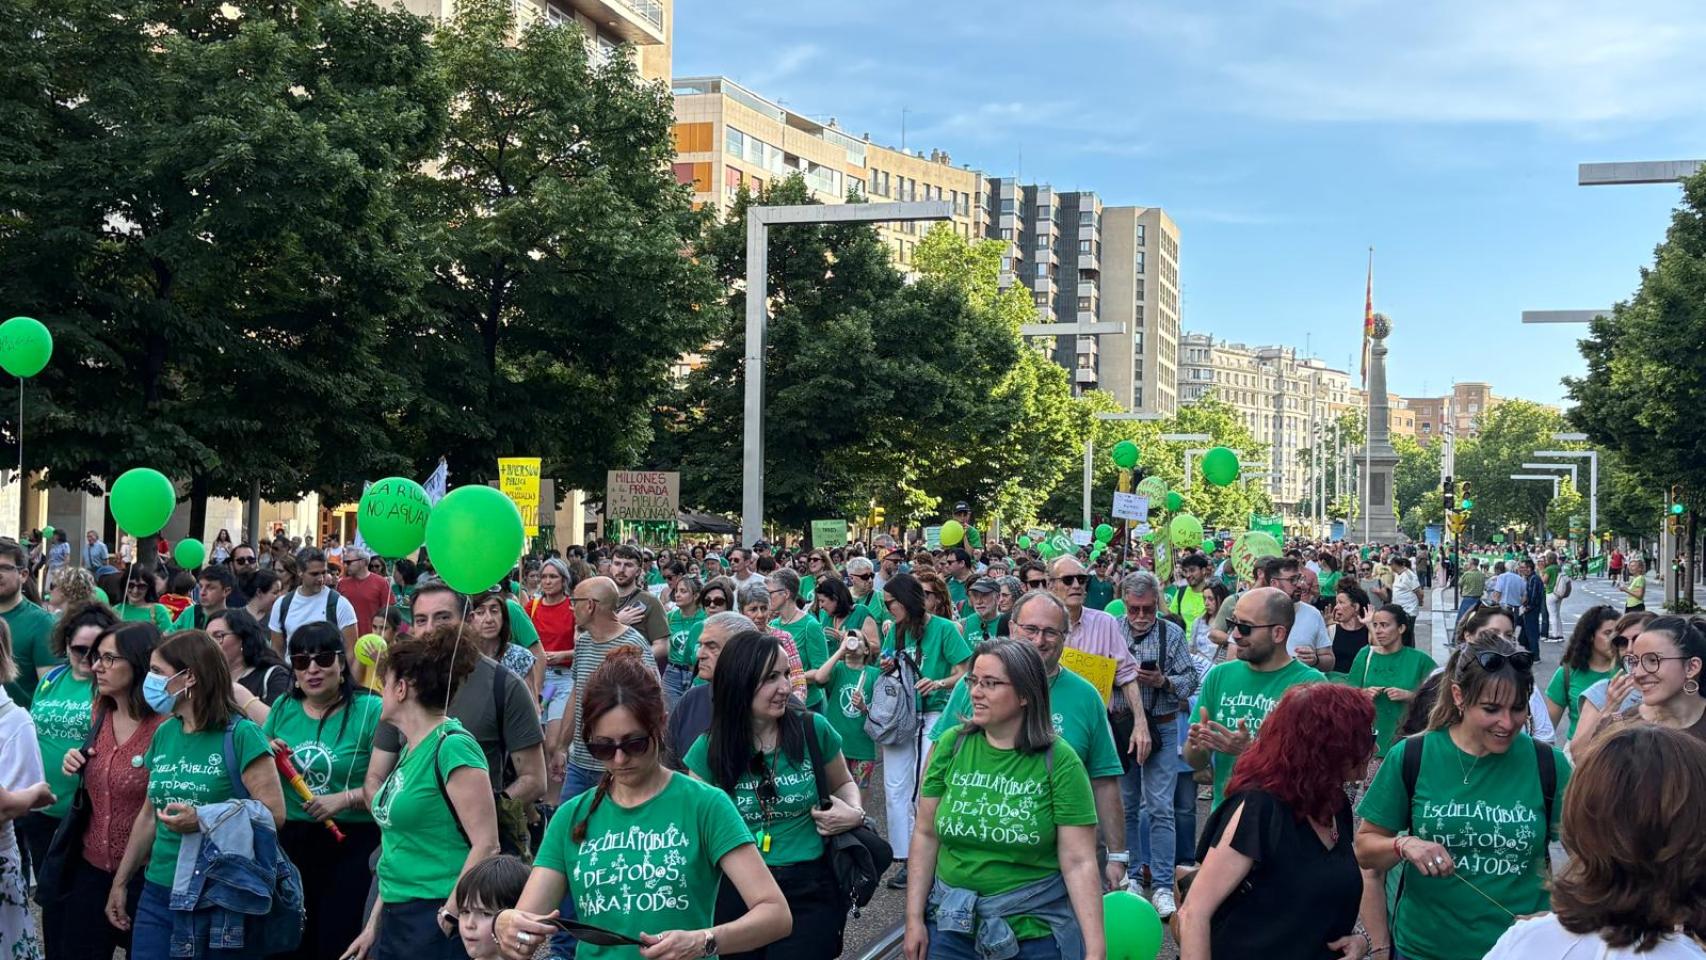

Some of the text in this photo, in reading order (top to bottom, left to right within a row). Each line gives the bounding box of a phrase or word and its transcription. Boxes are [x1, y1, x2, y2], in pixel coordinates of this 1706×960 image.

[615, 473, 666, 485] MILLONES
[629, 485, 669, 496] PRIVADA
[367, 500, 385, 517] NO
[1221, 690, 1260, 710] ESCUELA
[181, 761, 221, 776] PÚBLICA
[161, 780, 196, 791] TOD@S
[951, 770, 1043, 796] ESCUELA PÚBLICA
[737, 795, 754, 806] DE
[951, 800, 1030, 821] DE TOD@S
[1423, 800, 1537, 823] ESCUELA PÚBLICA
[938, 818, 1040, 845] PARA TOD@S
[578, 828, 690, 855] ESCUELA PÚBLICA
[1433, 832, 1528, 851] DE TOD@S
[583, 862, 680, 888] DE TOD@S
[622, 892, 690, 911] TOD@S
